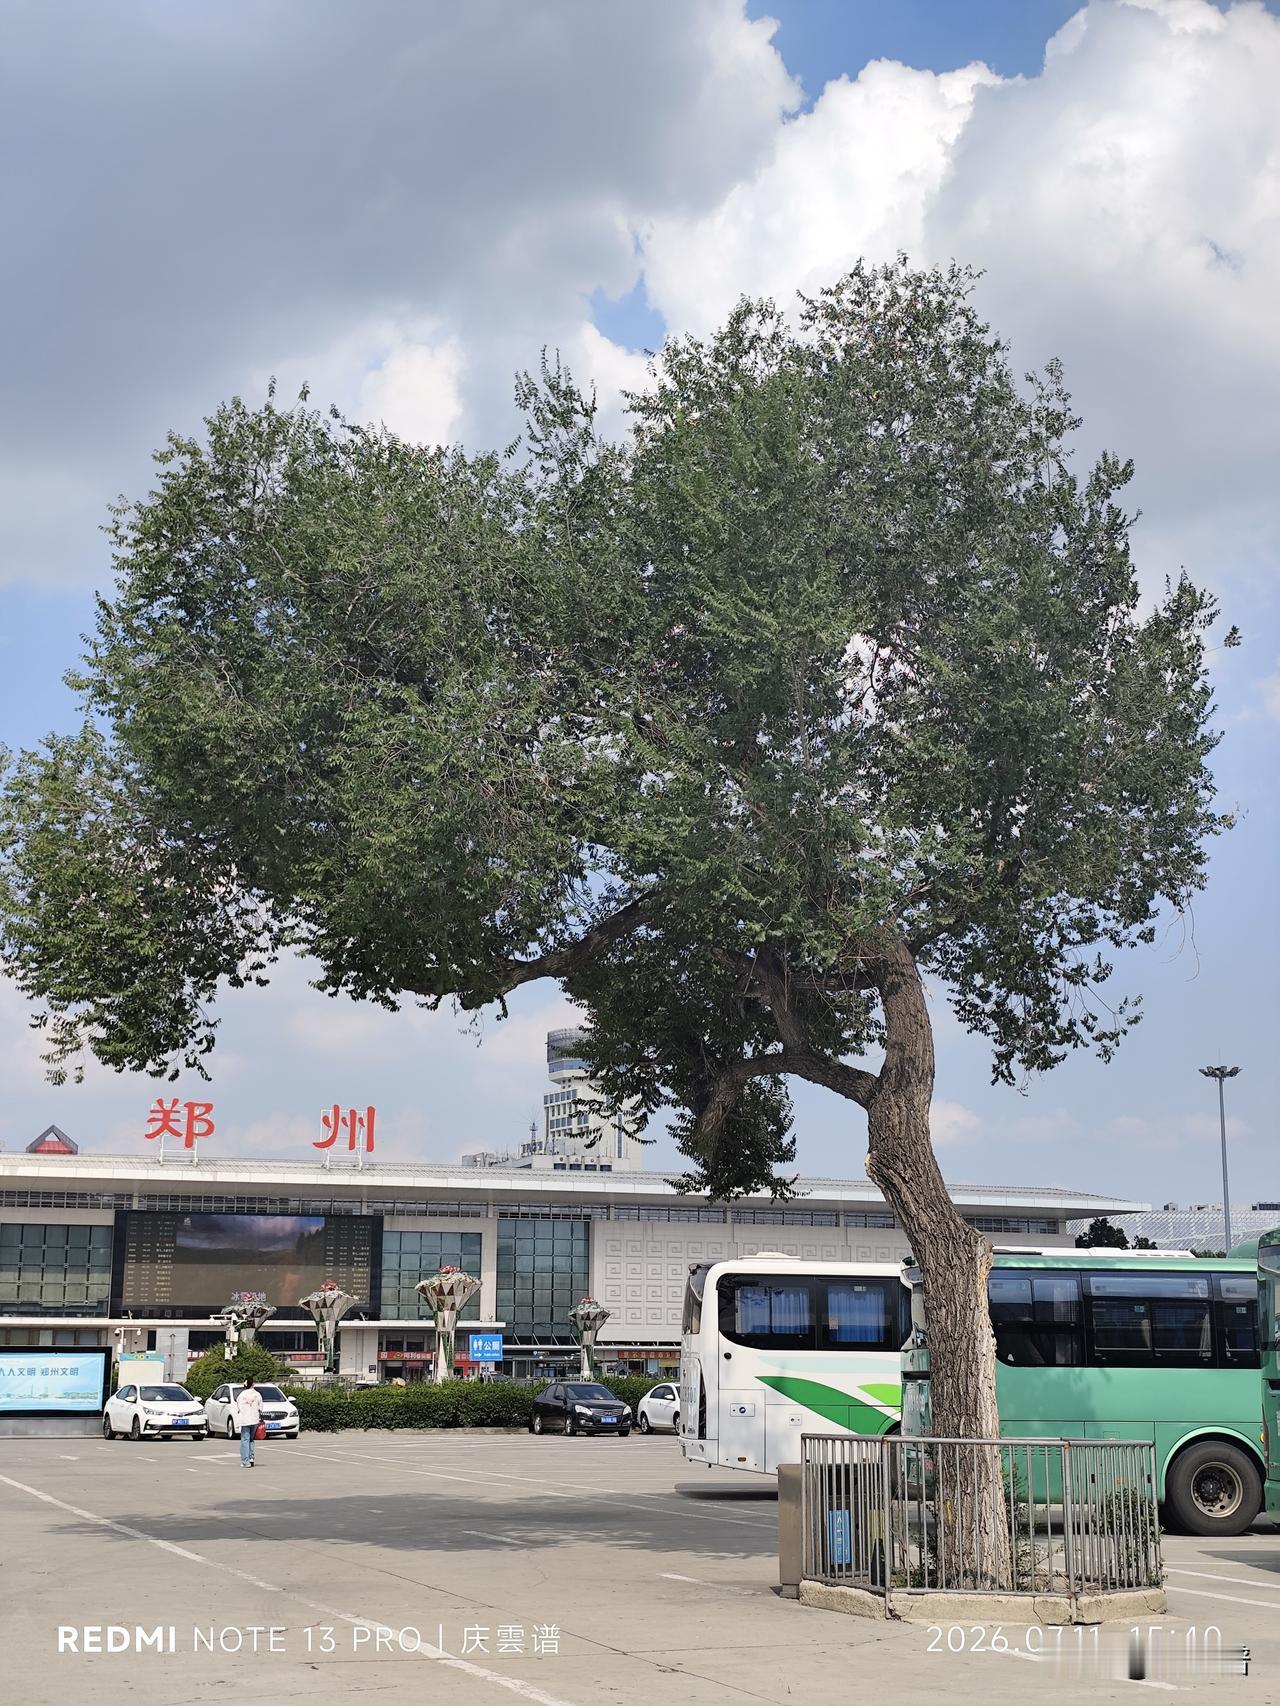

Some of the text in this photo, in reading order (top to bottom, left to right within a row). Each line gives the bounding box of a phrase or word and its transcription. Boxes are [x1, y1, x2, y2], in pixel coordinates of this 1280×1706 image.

[144, 1098, 376, 1153] 郑州
[40, 1367, 79, 1377] 郑州文明
